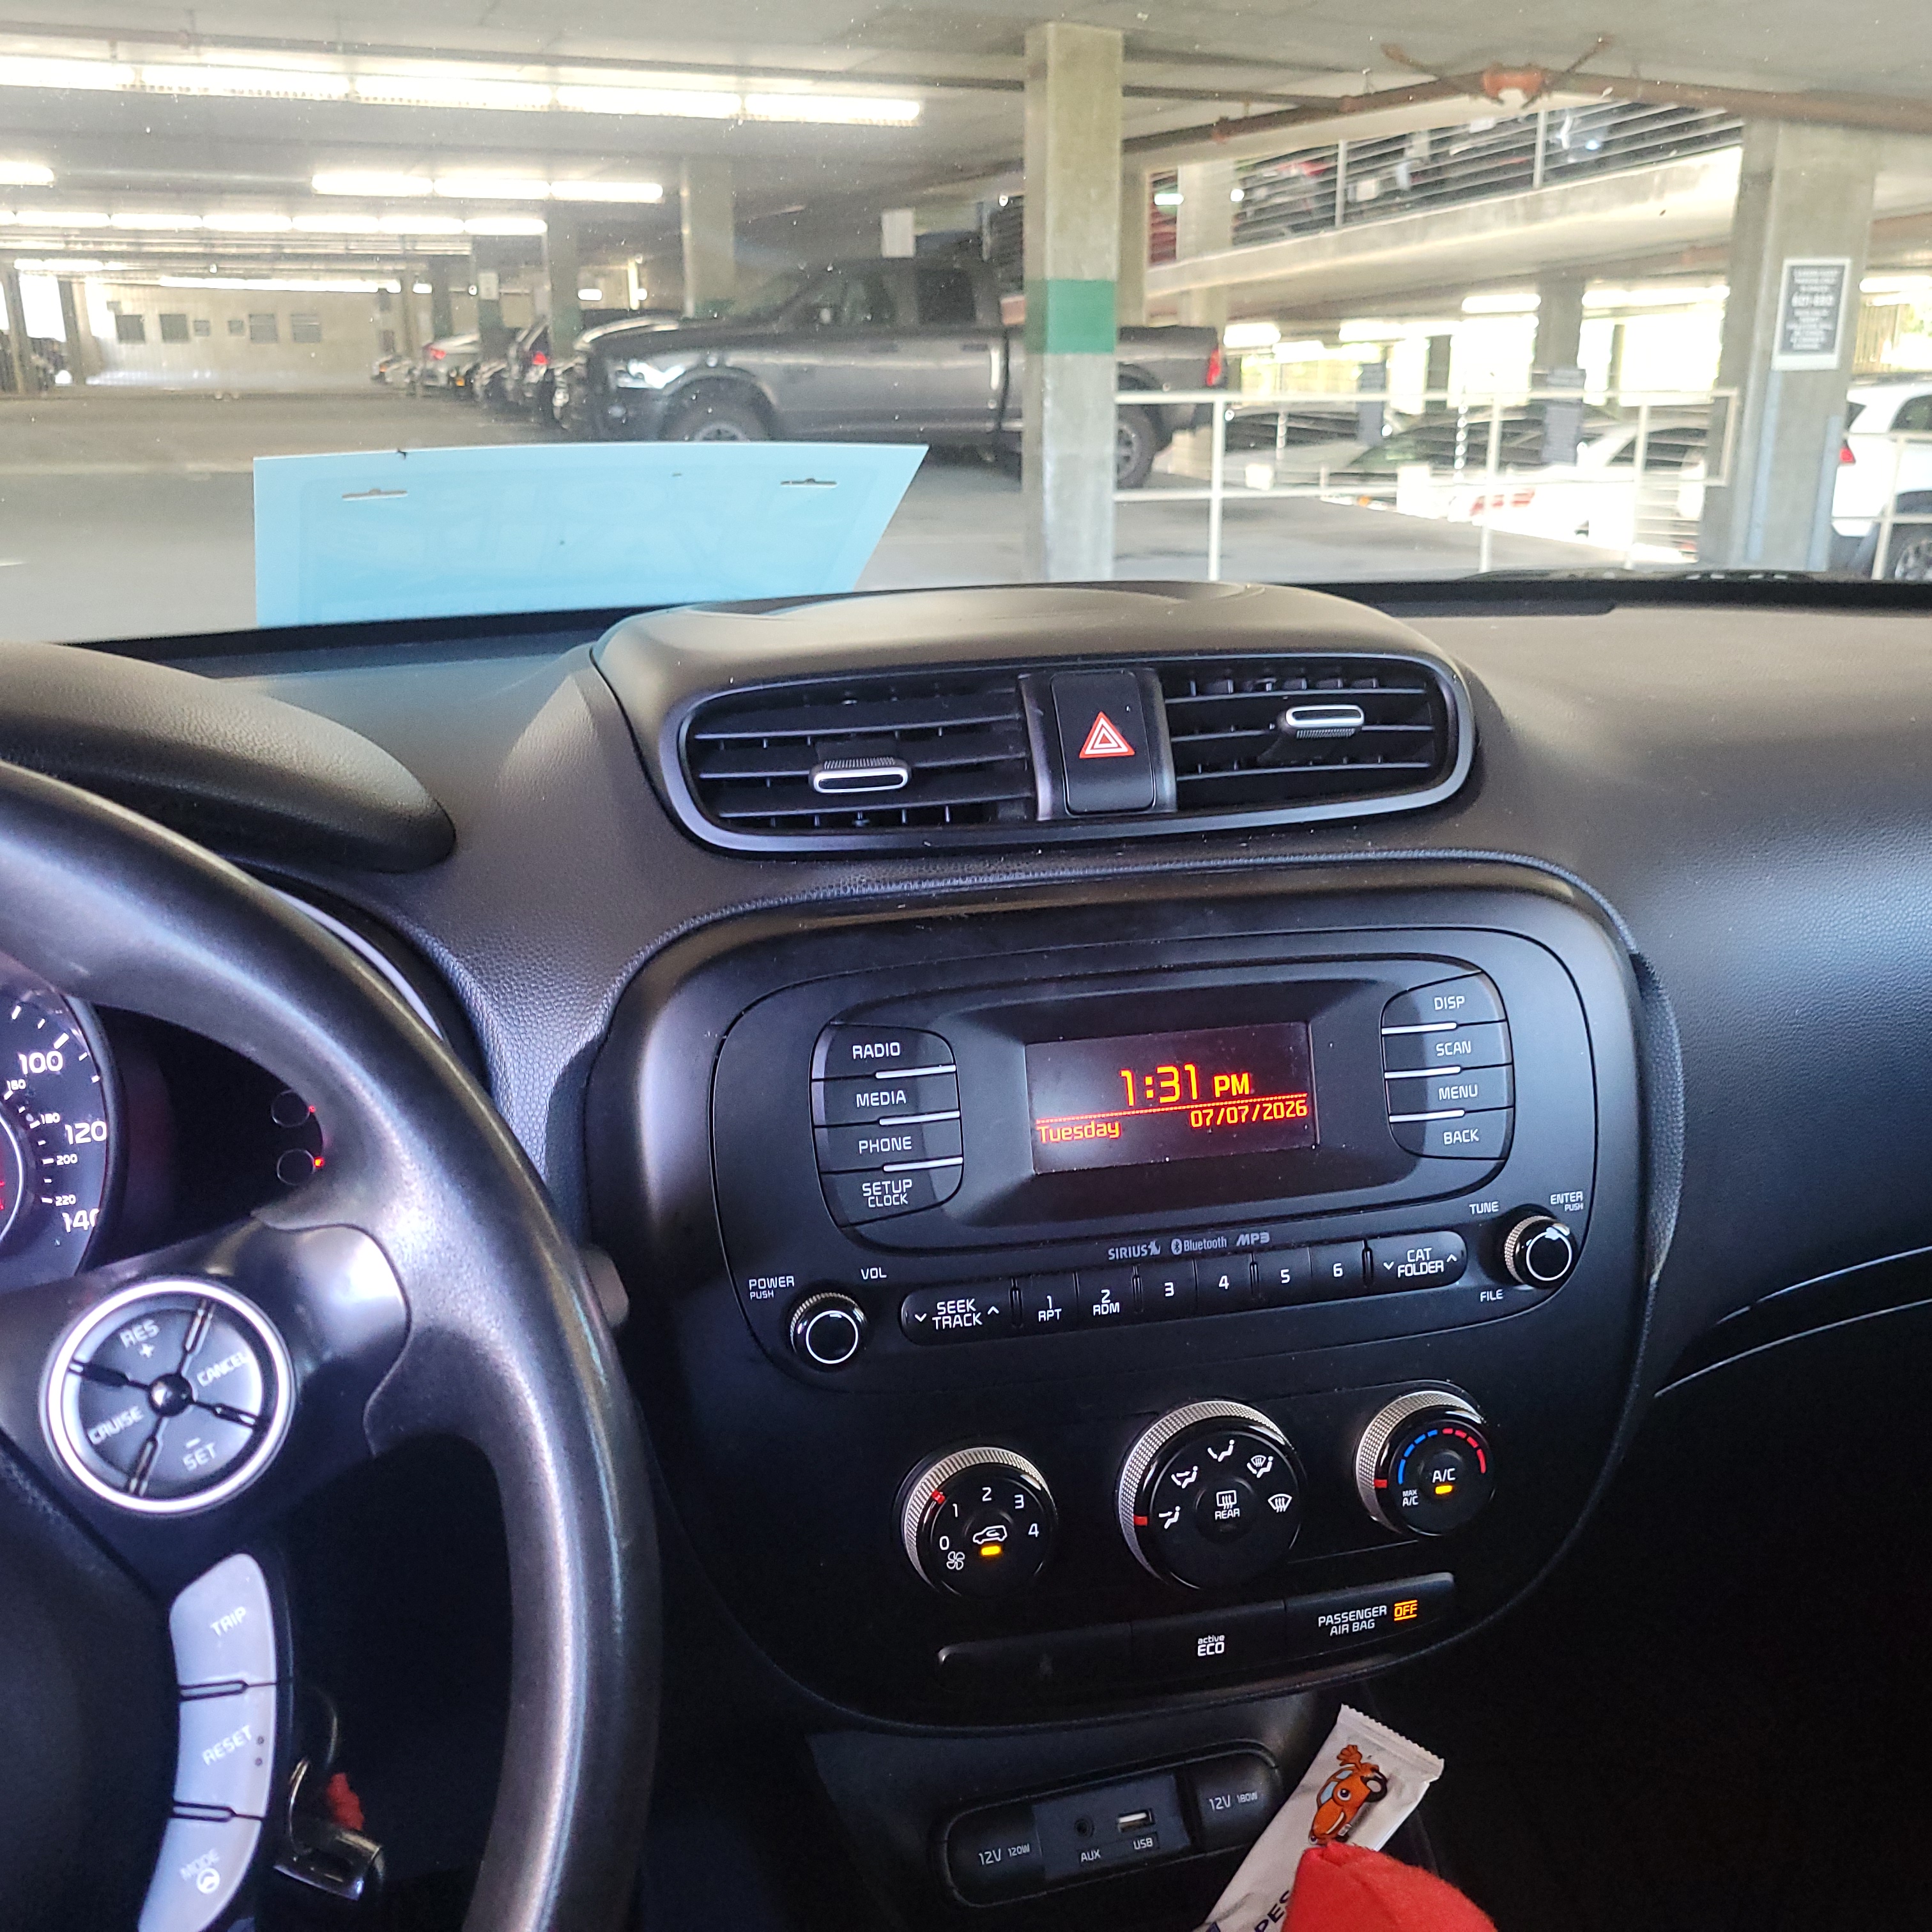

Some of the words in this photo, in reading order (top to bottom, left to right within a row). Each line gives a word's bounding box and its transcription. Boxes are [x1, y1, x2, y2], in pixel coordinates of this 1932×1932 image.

[1434, 995, 1465, 1010] DISP
[852, 1042, 901, 1059] RADIO
[1436, 1041, 1471, 1057] SCAN
[19, 1050, 63, 1075] 100
[1119, 1062, 1199, 1107] 1:31
[1213, 1071, 1250, 1098] PM
[856, 1090, 907, 1107] MEDIA
[1438, 1084, 1478, 1101] MENU
[1036, 1121, 1121, 1144] Tuesday
[1190, 1100, 1308, 1128] 07/07/2026
[65, 1120, 107, 1145] 120
[1443, 1128, 1480, 1145] BACK
[859, 1136, 912, 1154] PHONE
[56, 1153, 78, 1165] 200
[862, 1179, 912, 1197] SETUP
[55, 1194, 76, 1207] 220
[868, 1193, 908, 1208] CLOCK
[1550, 1190, 1583, 1206] ENTER
[1469, 1201, 1499, 1215] TUNE
[1564, 1202, 1583, 1212] PUSH
[1184, 1236, 1227, 1252] Bluetooth
[1236, 1231, 1270, 1246] MP3
[1108, 1246, 1149, 1260] SIRIUS
[1406, 1247, 1432, 1262] CAT
[861, 1268, 887, 1280] VOL
[1280, 1268, 1290, 1284] 5
[1333, 1262, 1343, 1277] 6
[1397, 1261, 1444, 1278] FOLDER
[749, 1276, 795, 1290] POWER
[1165, 1282, 1174, 1297] 3
[1218, 1275, 1229, 1289] 4
[749, 1289, 774, 1300] PUSH
[1046, 1295, 1053, 1309] 1
[1100, 1289, 1110, 1303] 2
[1480, 1289, 1503, 1302] FILE
[936, 1298, 977, 1315] SEEK
[1092, 1301, 1120, 1316] RDM
[931, 1313, 983, 1330] TRACK
[1038, 1308, 1062, 1322] RPT
[119, 1319, 159, 1348] RES
[196, 1351, 248, 1387] CANCEL
[88, 1406, 143, 1445] CRUISE
[183, 1442, 216, 1471] SET
[1432, 1468, 1457, 1483] A/C
[982, 1487, 992, 1501] 2
[1015, 1494, 1024, 1509] 3
[1402, 1496, 1418, 1507] A/C
[953, 1503, 958, 1518] 1
[1215, 1508, 1240, 1521] REAR
[1028, 1523, 1039, 1538] 4
[939, 1536, 950, 1551] 0
[210, 1606, 246, 1637] TRIP
[1318, 1605, 1387, 1627] PASSENGER
[1394, 1602, 1418, 1618] OFF
[1330, 1624, 1349, 1637] AIR
[1352, 1619, 1376, 1633] BAG
[1197, 1634, 1225, 1644] active
[1197, 1641, 1225, 1657] ECO
[203, 1725, 252, 1766] RESET
[1209, 1795, 1231, 1811] 12V
[1236, 1791, 1258, 1805] 180W
[1132, 1837, 1153, 1850] USB
[978, 1849, 1002, 1866] 12V
[1008, 1843, 1031, 1858] 120W
[1080, 1849, 1101, 1862] AUX
